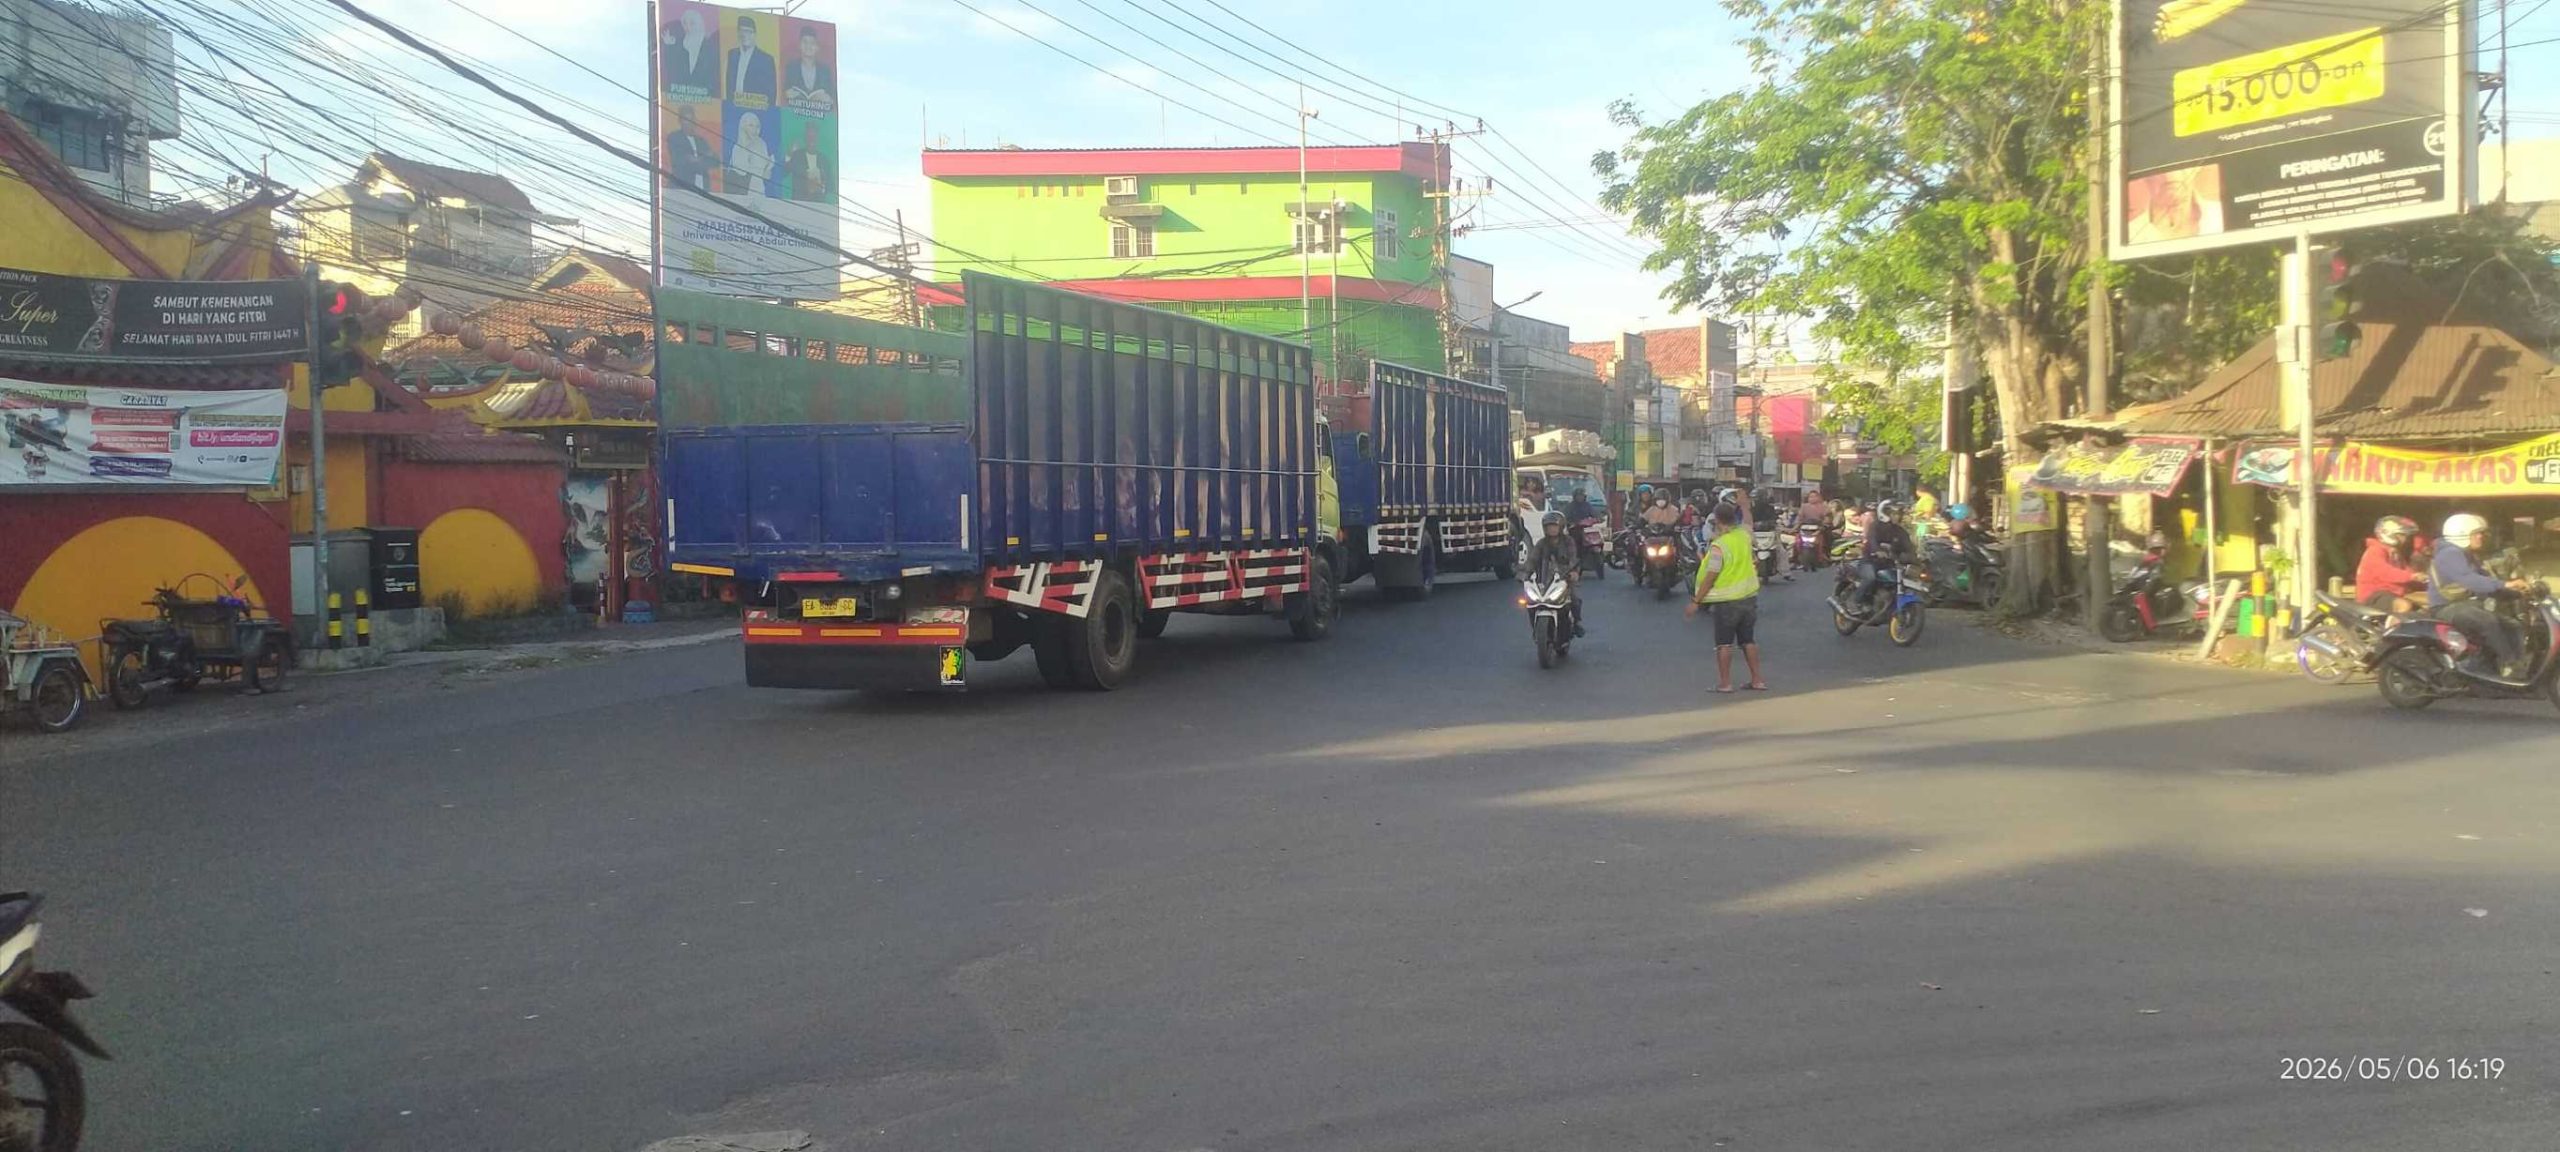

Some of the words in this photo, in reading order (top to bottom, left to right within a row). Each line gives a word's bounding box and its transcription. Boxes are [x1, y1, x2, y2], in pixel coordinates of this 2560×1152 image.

[2280, 148, 2386, 179] PERINGATAN:
[153, 295, 199, 309] SAMBUT
[200, 294, 274, 309] KEMENANGAN
[0, 290, 59, 333] Super
[162, 312, 175, 325] DI
[178, 312, 203, 325] HARI
[205, 311, 236, 324] YANG
[238, 310, 267, 324] FITRI
[122, 333, 171, 346] SELAMAT
[171, 334, 195, 346] HARI
[196, 333, 223, 345] RAYA
[224, 332, 248, 344] IDUL
[249, 331, 272, 342] FITRI
